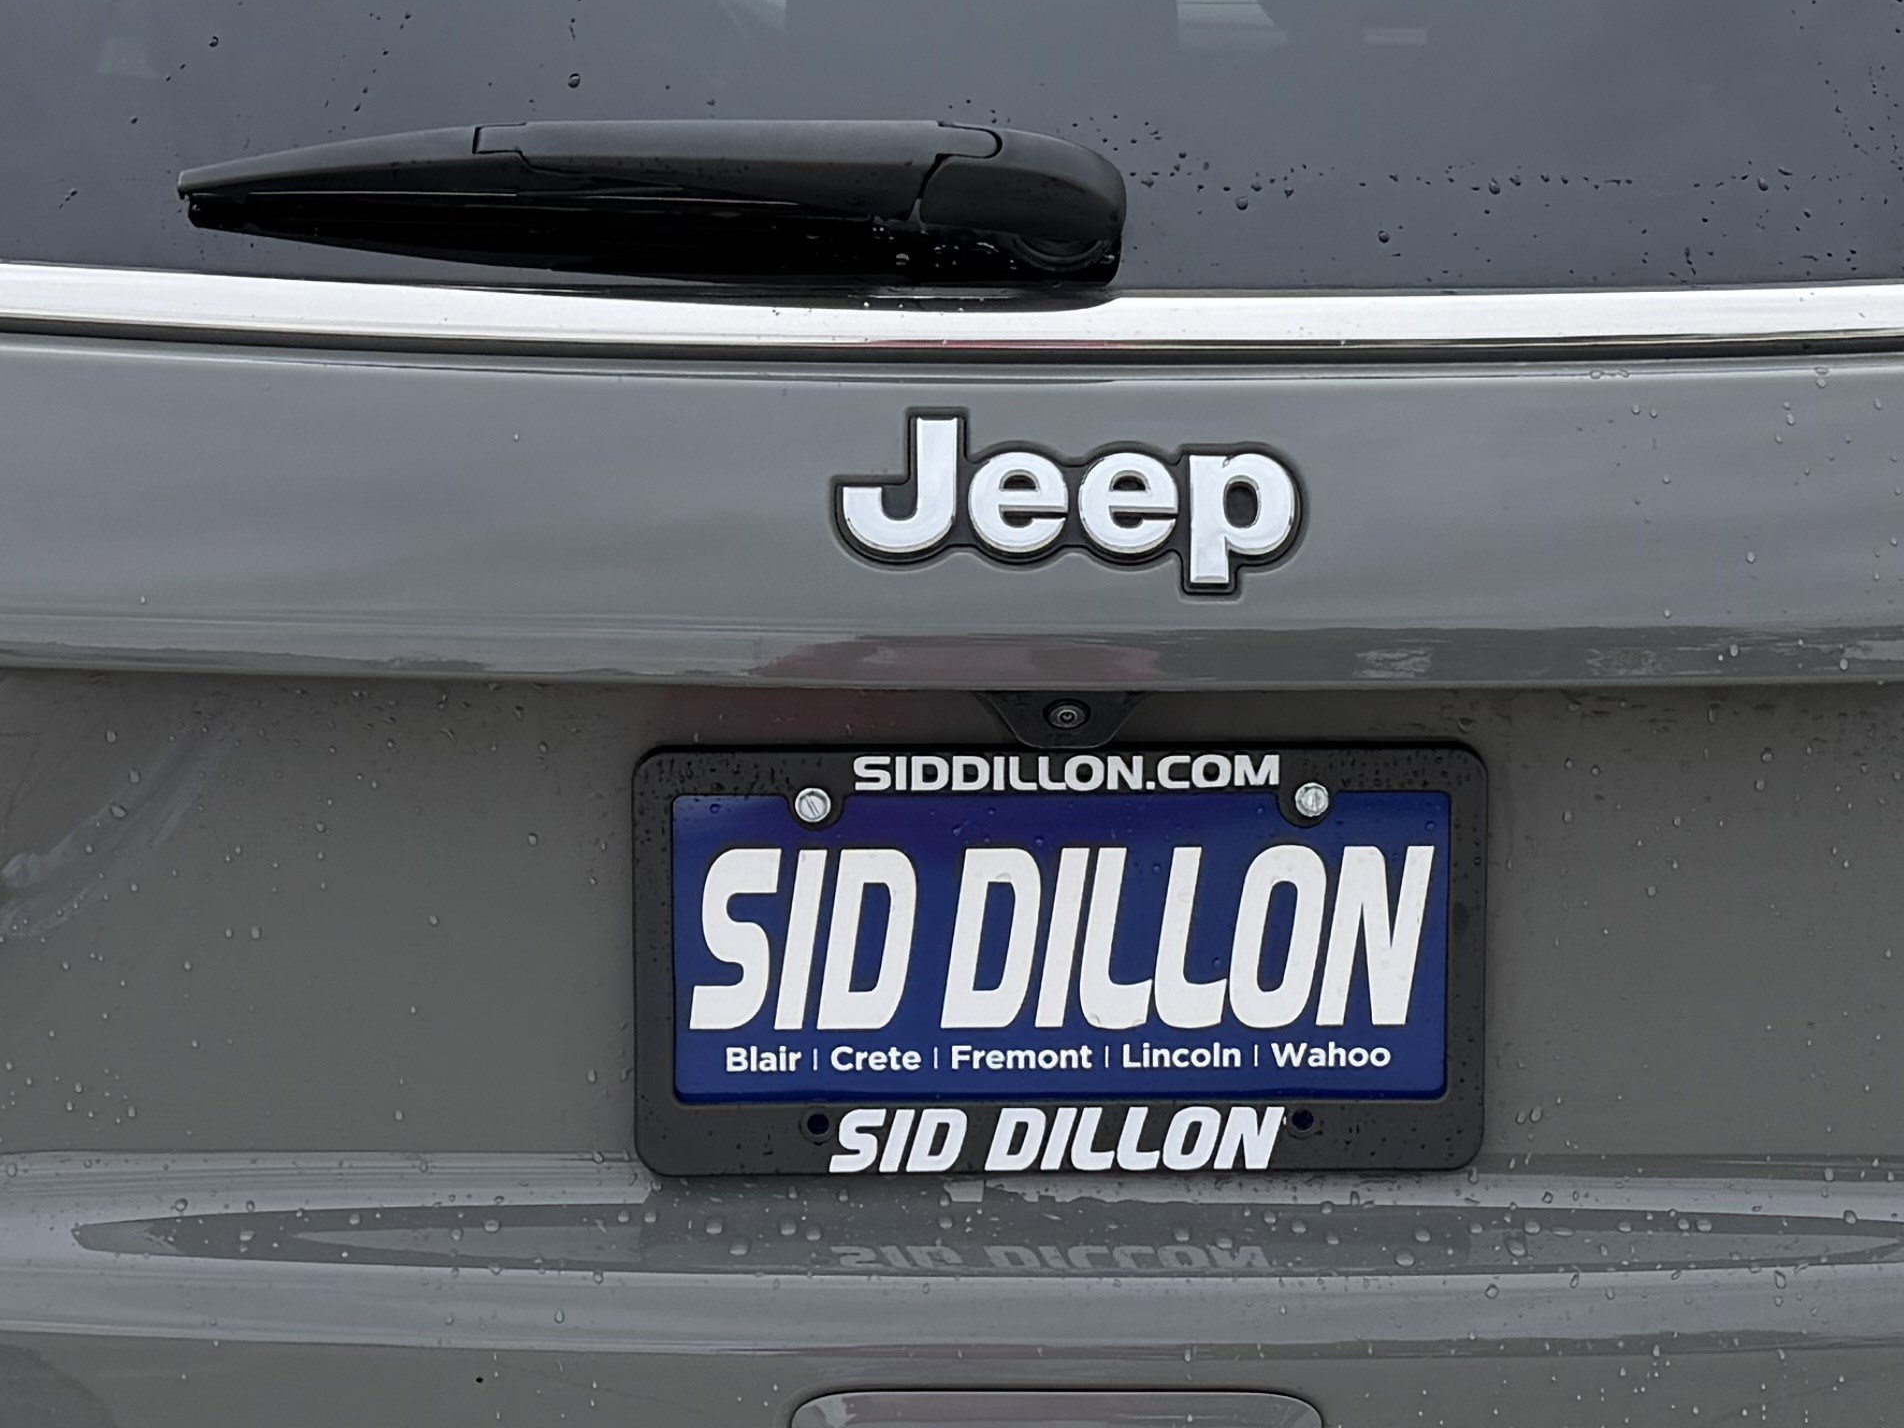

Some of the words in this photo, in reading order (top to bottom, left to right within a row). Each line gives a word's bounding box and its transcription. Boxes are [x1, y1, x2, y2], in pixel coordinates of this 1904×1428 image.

[841, 416, 1296, 585] Jeep
[853, 754, 1281, 791] SIDDILLON.COM
[689, 847, 917, 1031] SID
[940, 845, 1435, 1029] DILLON
[725, 1046, 802, 1072] Blair
[830, 1047, 921, 1072] Crete
[950, 1044, 1093, 1070] Fremont
[1122, 1042, 1242, 1069] Lincoln
[1270, 1043, 1392, 1069] Wahoo
[829, 1109, 965, 1172] SID
[985, 1106, 1286, 1171] DILLON
